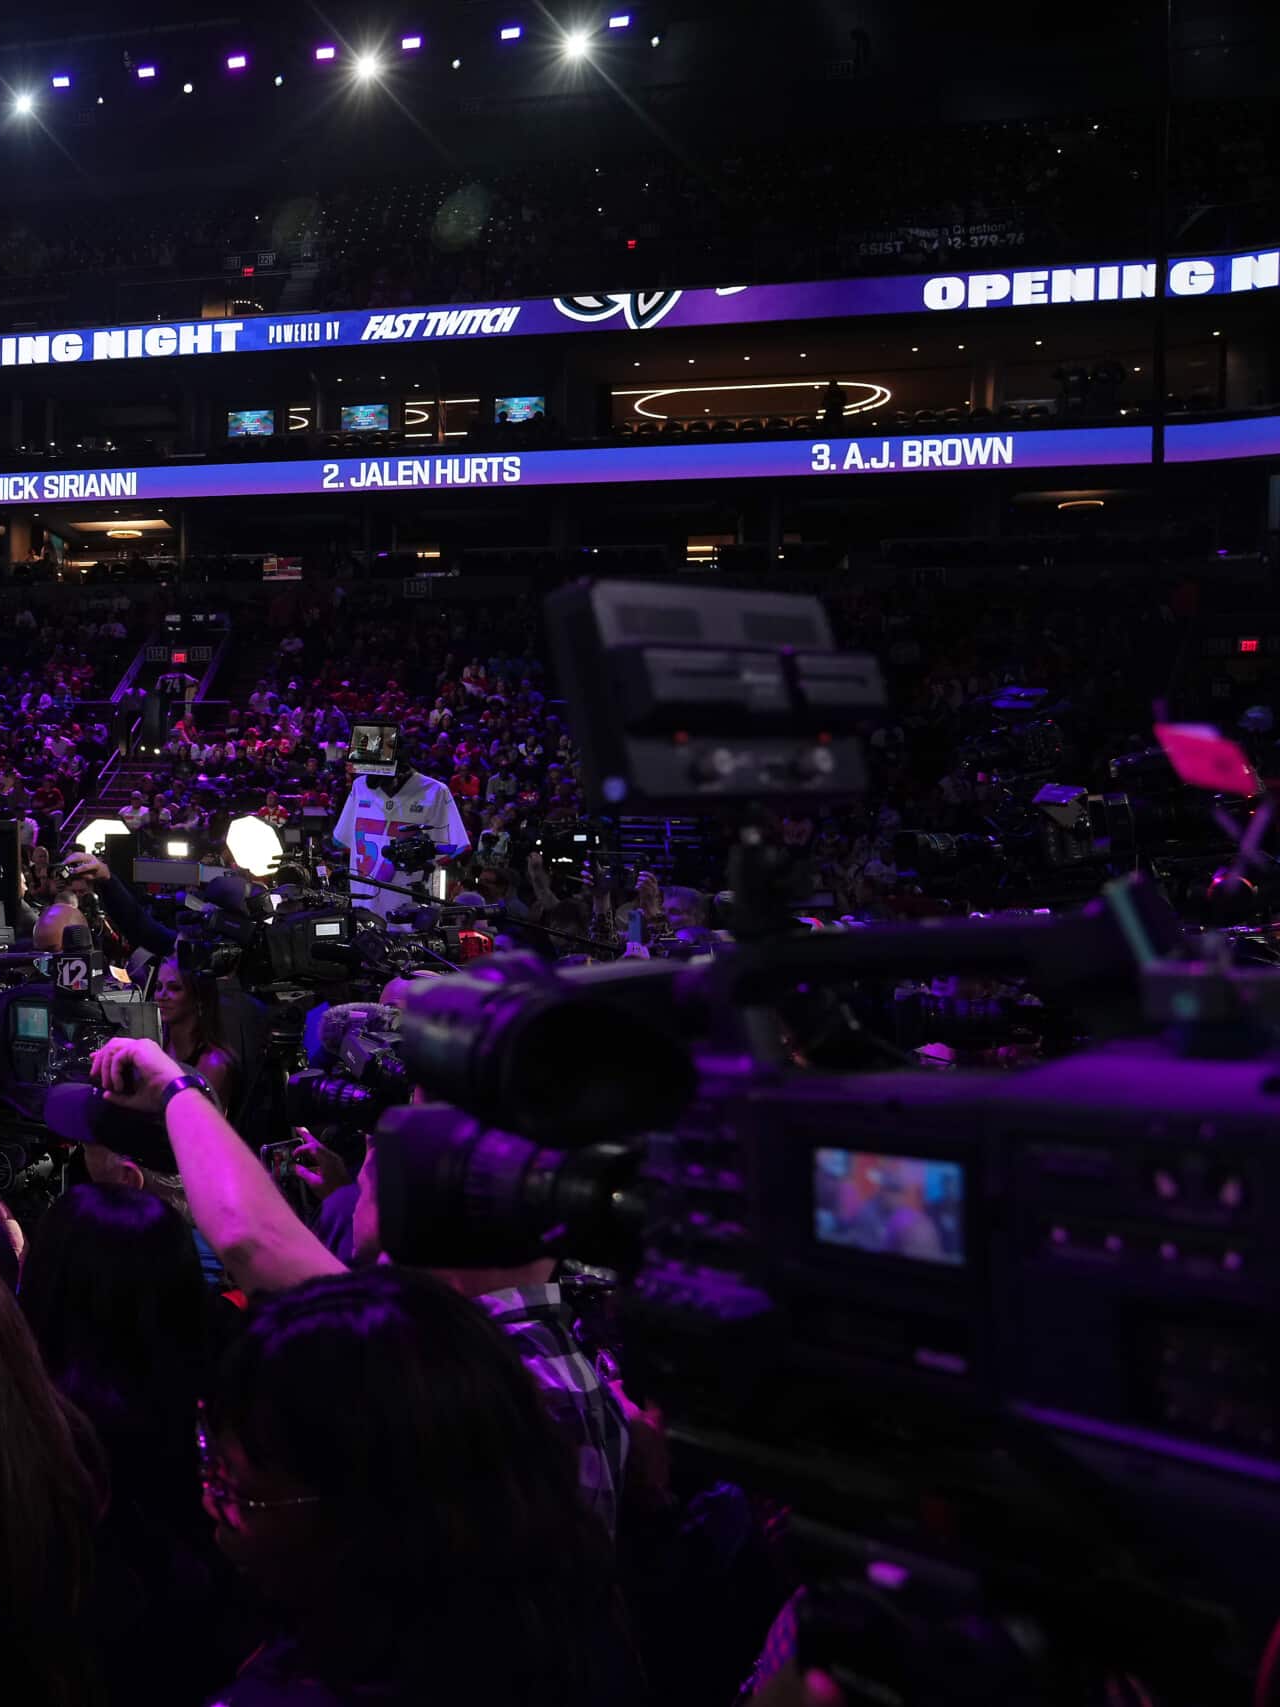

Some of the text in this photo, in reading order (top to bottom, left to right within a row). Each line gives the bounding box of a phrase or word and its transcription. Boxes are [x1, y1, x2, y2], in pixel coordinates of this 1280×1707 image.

[923, 260, 1215, 310] OPENING
[93, 322, 244, 361] NIGHT
[268, 322, 321, 344] POWERED
[326, 321, 340, 341] BY
[360, 312, 427, 341] FAST
[422, 306, 521, 337] TWITCH
[811, 436, 1013, 471] 3. A.J. BROWN
[43, 471, 137, 499] SIRIANNI
[322, 456, 521, 490] 2. JALEN HURTS
[63, 959, 88, 987] 12
